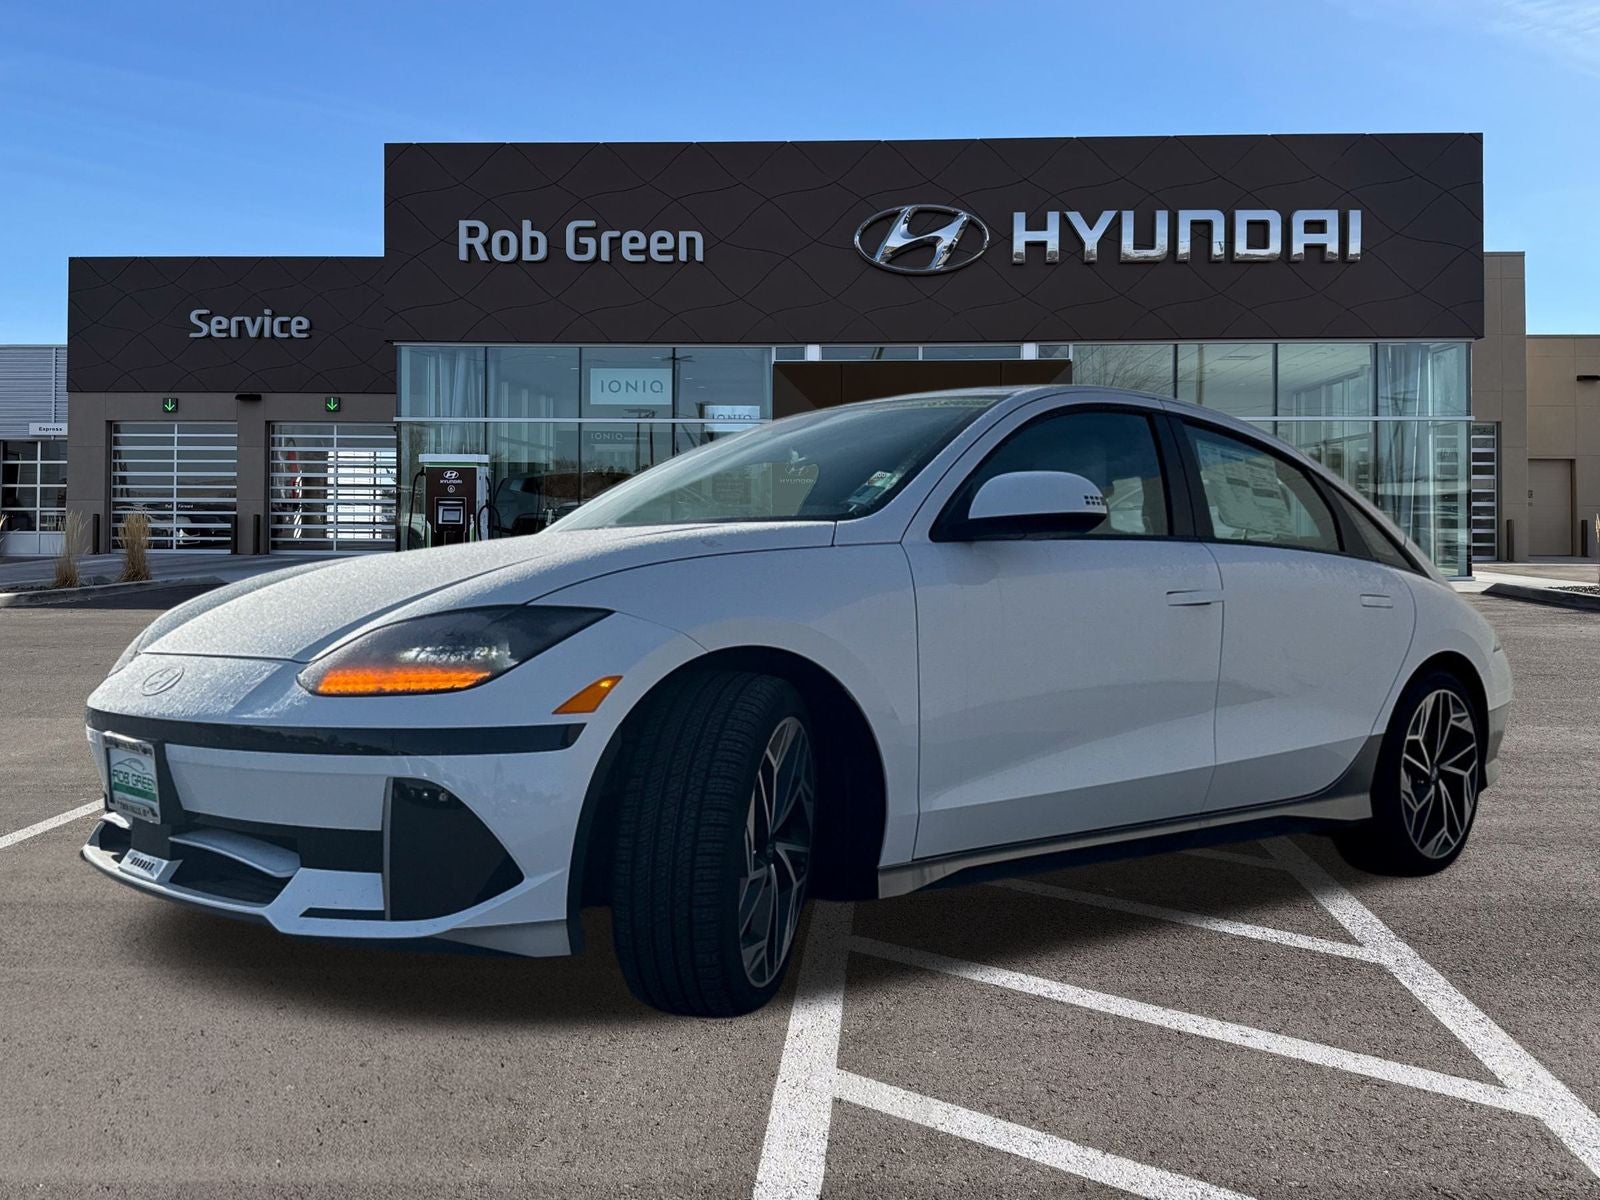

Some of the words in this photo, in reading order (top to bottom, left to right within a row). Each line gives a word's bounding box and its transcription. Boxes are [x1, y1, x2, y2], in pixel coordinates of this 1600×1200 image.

[458, 219, 549, 262] Rob
[565, 219, 705, 263] Green
[1011, 208, 1363, 265] HYUNDAI
[189, 308, 311, 339] Service
[600, 379, 664, 394] IONIQ
[590, 432, 624, 441] IONIQ
